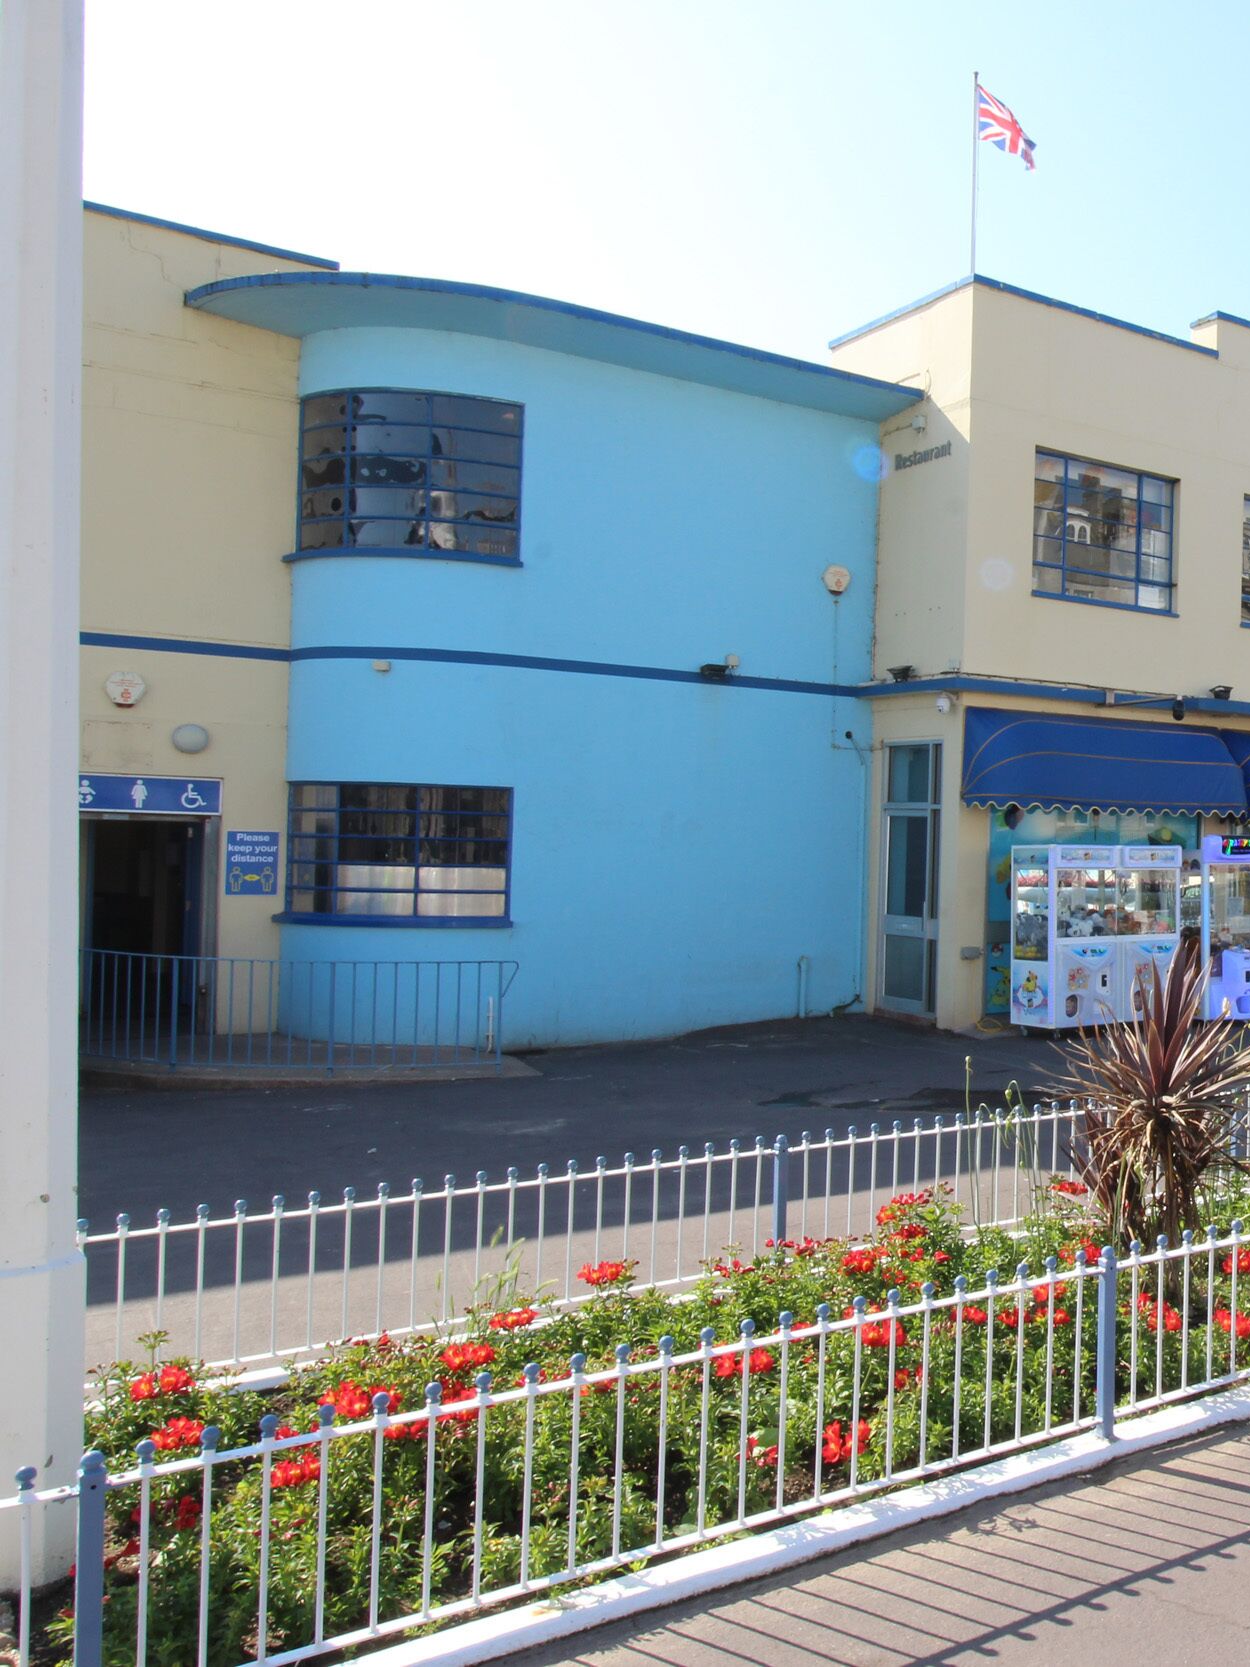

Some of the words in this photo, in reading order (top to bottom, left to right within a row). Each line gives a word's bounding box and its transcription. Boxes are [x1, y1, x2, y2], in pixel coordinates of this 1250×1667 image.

[895, 440, 952, 471] Restaurant
[236, 833, 269, 842] Please
[228, 843, 252, 853] keep
[254, 845, 277, 853] your
[231, 854, 274, 863] distance
